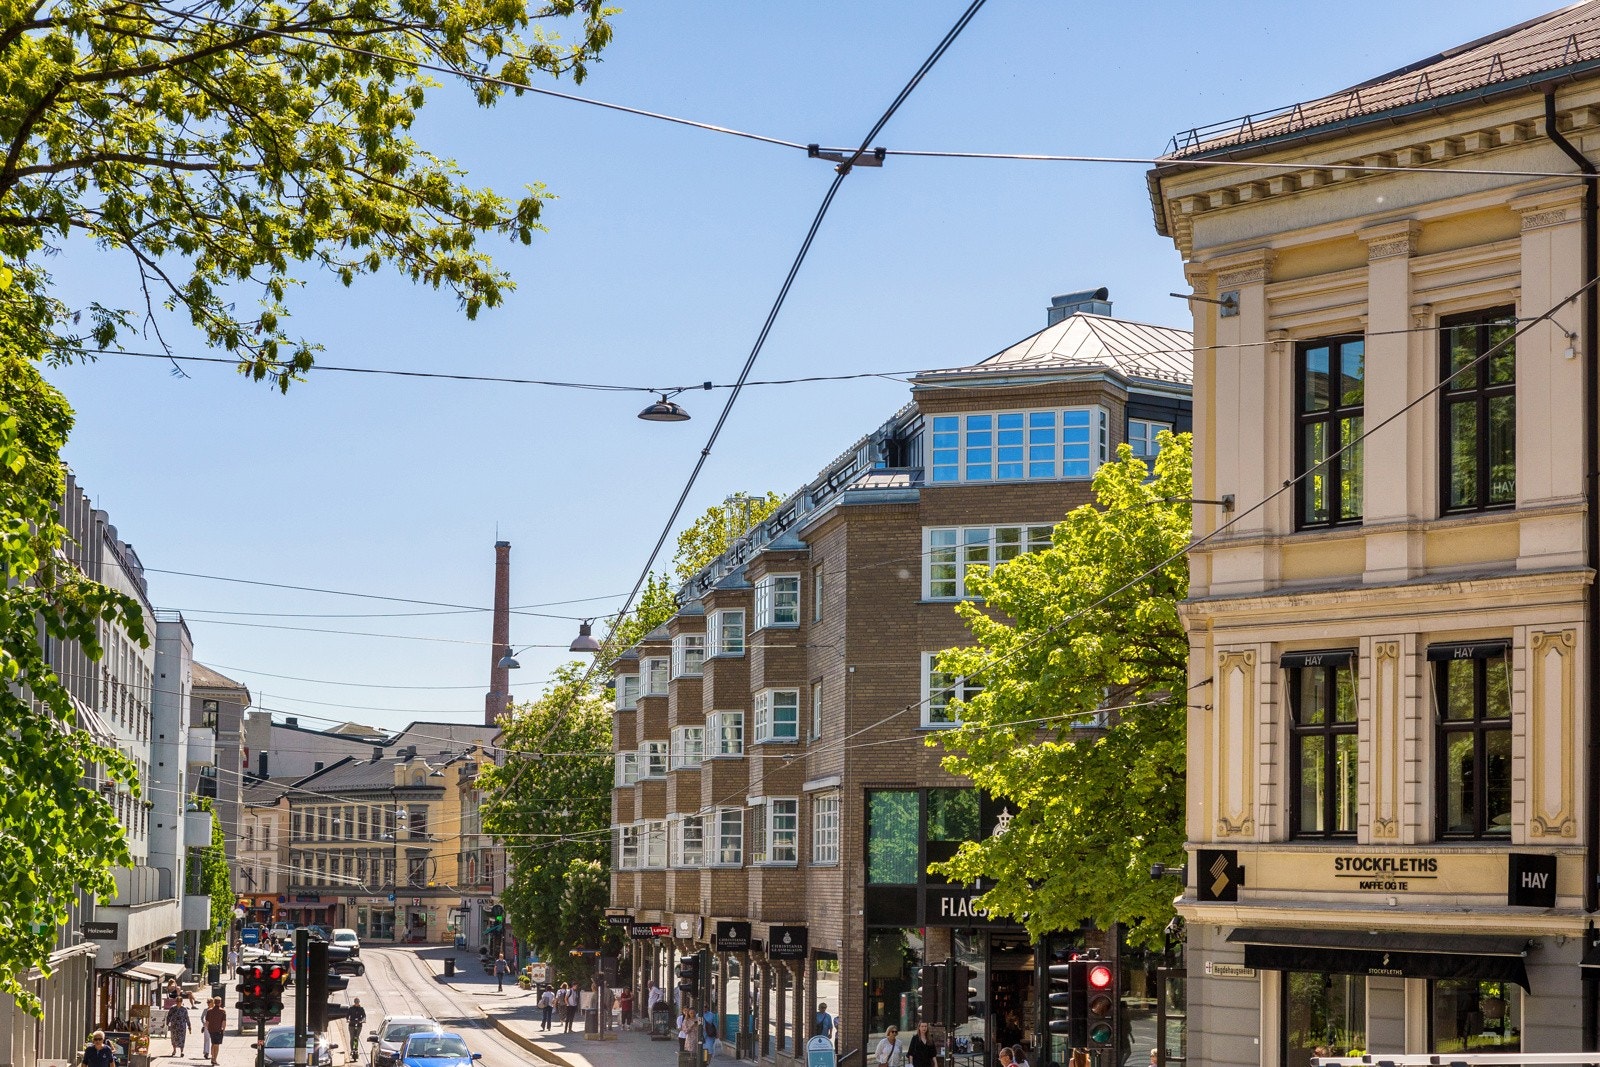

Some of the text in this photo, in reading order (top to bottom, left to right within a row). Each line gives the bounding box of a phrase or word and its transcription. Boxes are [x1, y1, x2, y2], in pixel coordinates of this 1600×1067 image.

[1493, 480, 1515, 494] HAY
[1454, 647, 1474, 658] HAY
[1304, 655, 1323, 666] HAY
[1334, 856, 1438, 872] STOCKFLETHS
[1521, 871, 1549, 889] HAY
[1359, 881, 1408, 891] KAFFE OG TE
[1368, 968, 1403, 976] STOCKFLETHS
